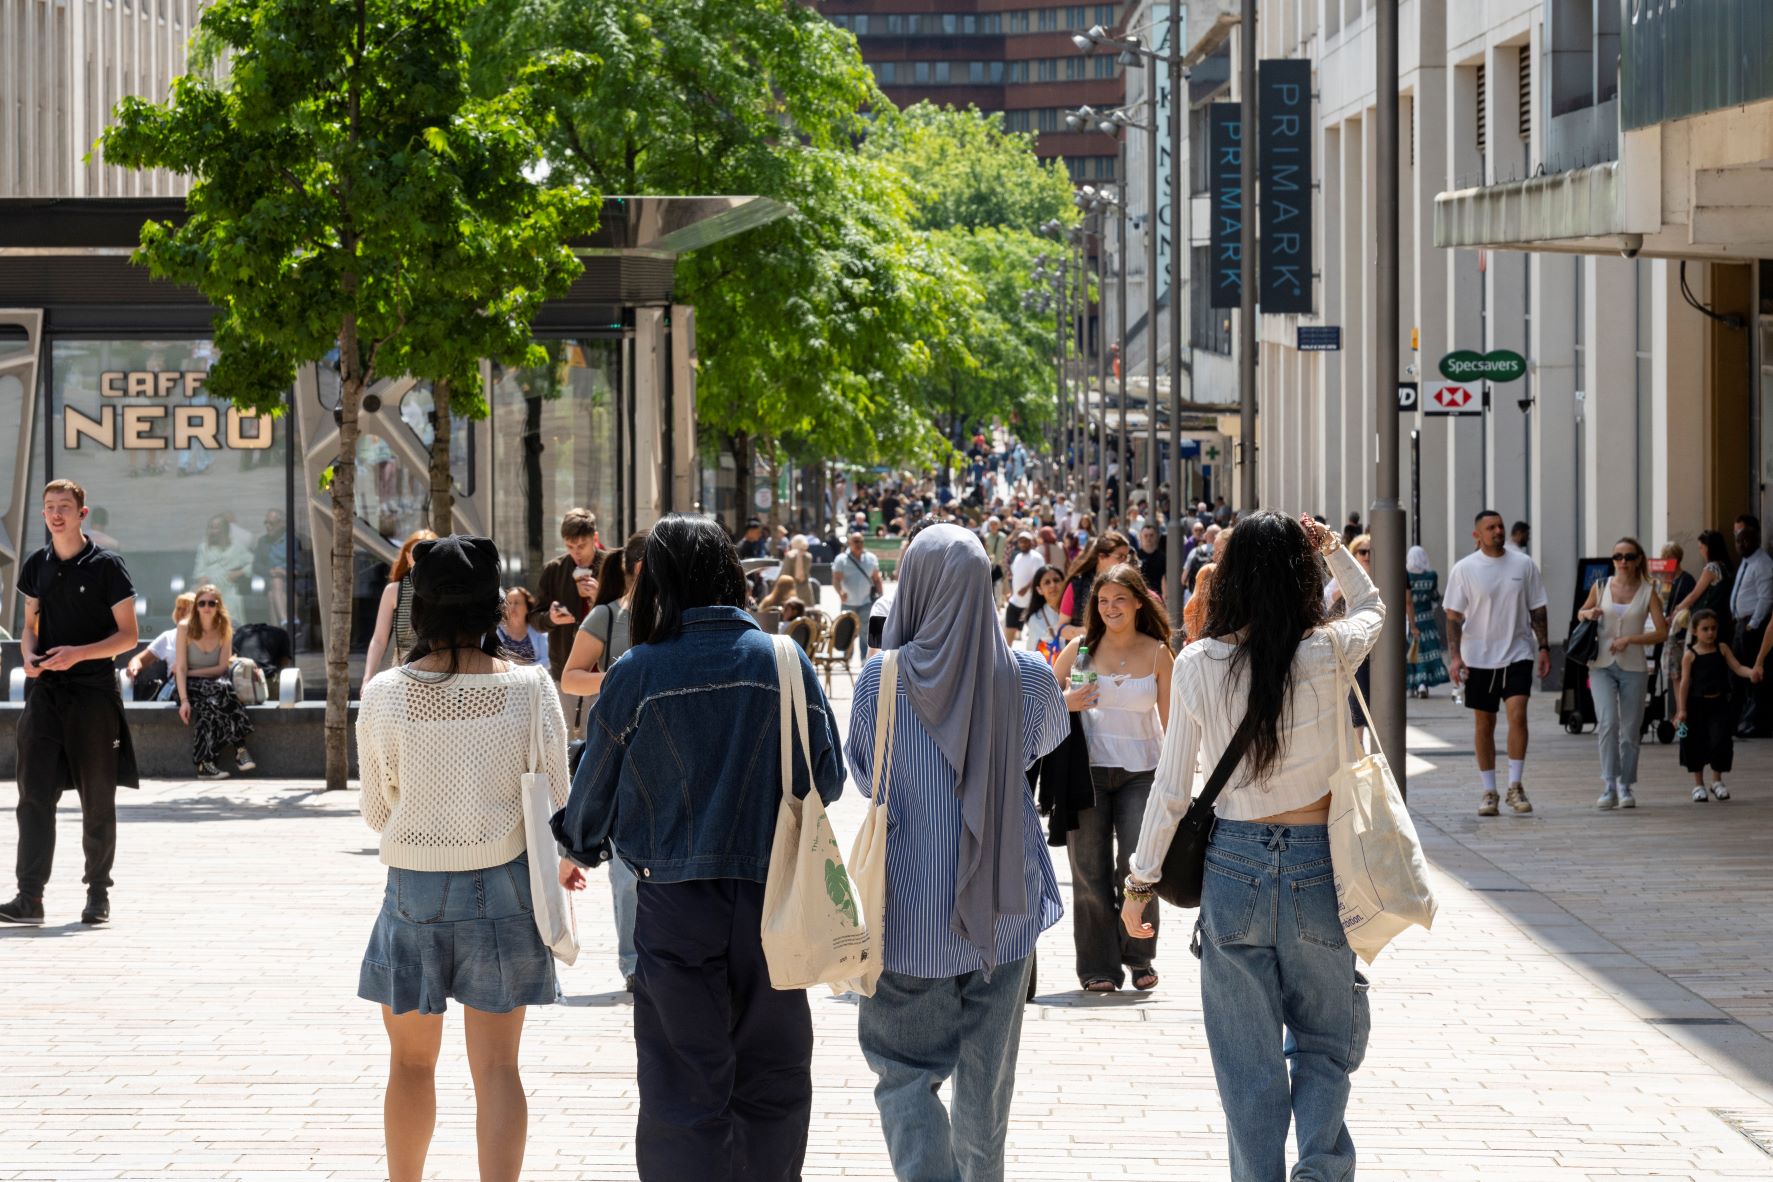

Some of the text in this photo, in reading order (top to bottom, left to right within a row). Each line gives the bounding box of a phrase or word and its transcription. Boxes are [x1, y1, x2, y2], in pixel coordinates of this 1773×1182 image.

[1220, 121, 1242, 288] PRIMARK
[1272, 83, 1300, 288] PRIMARK
[101, 372, 208, 397] CAFF
[1447, 359, 1519, 374] Specsavers
[64, 405, 274, 450] NERO
